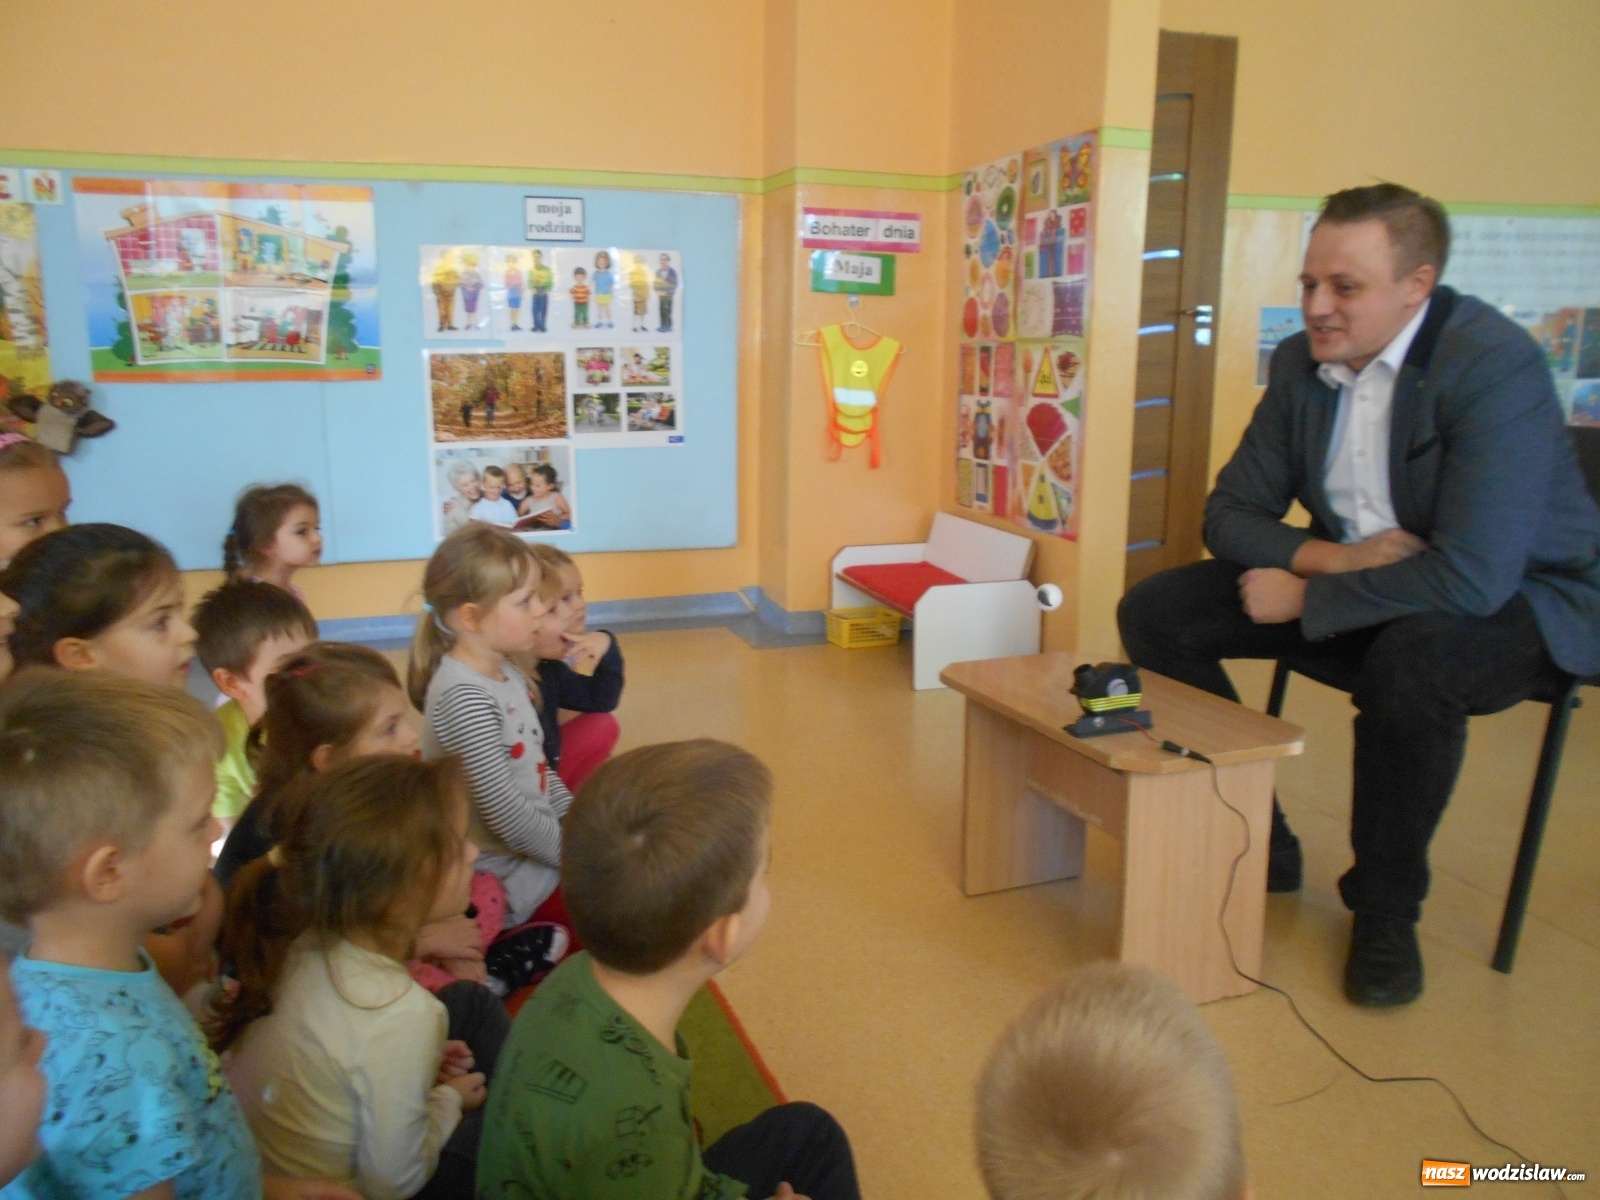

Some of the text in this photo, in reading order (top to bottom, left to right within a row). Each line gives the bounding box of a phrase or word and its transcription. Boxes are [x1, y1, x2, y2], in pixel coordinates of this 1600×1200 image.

[536, 202, 573, 217] moja
[528, 221, 583, 234] rodzina
[810, 221, 916, 240] Bohater dnia
[834, 259, 873, 279] Maja
